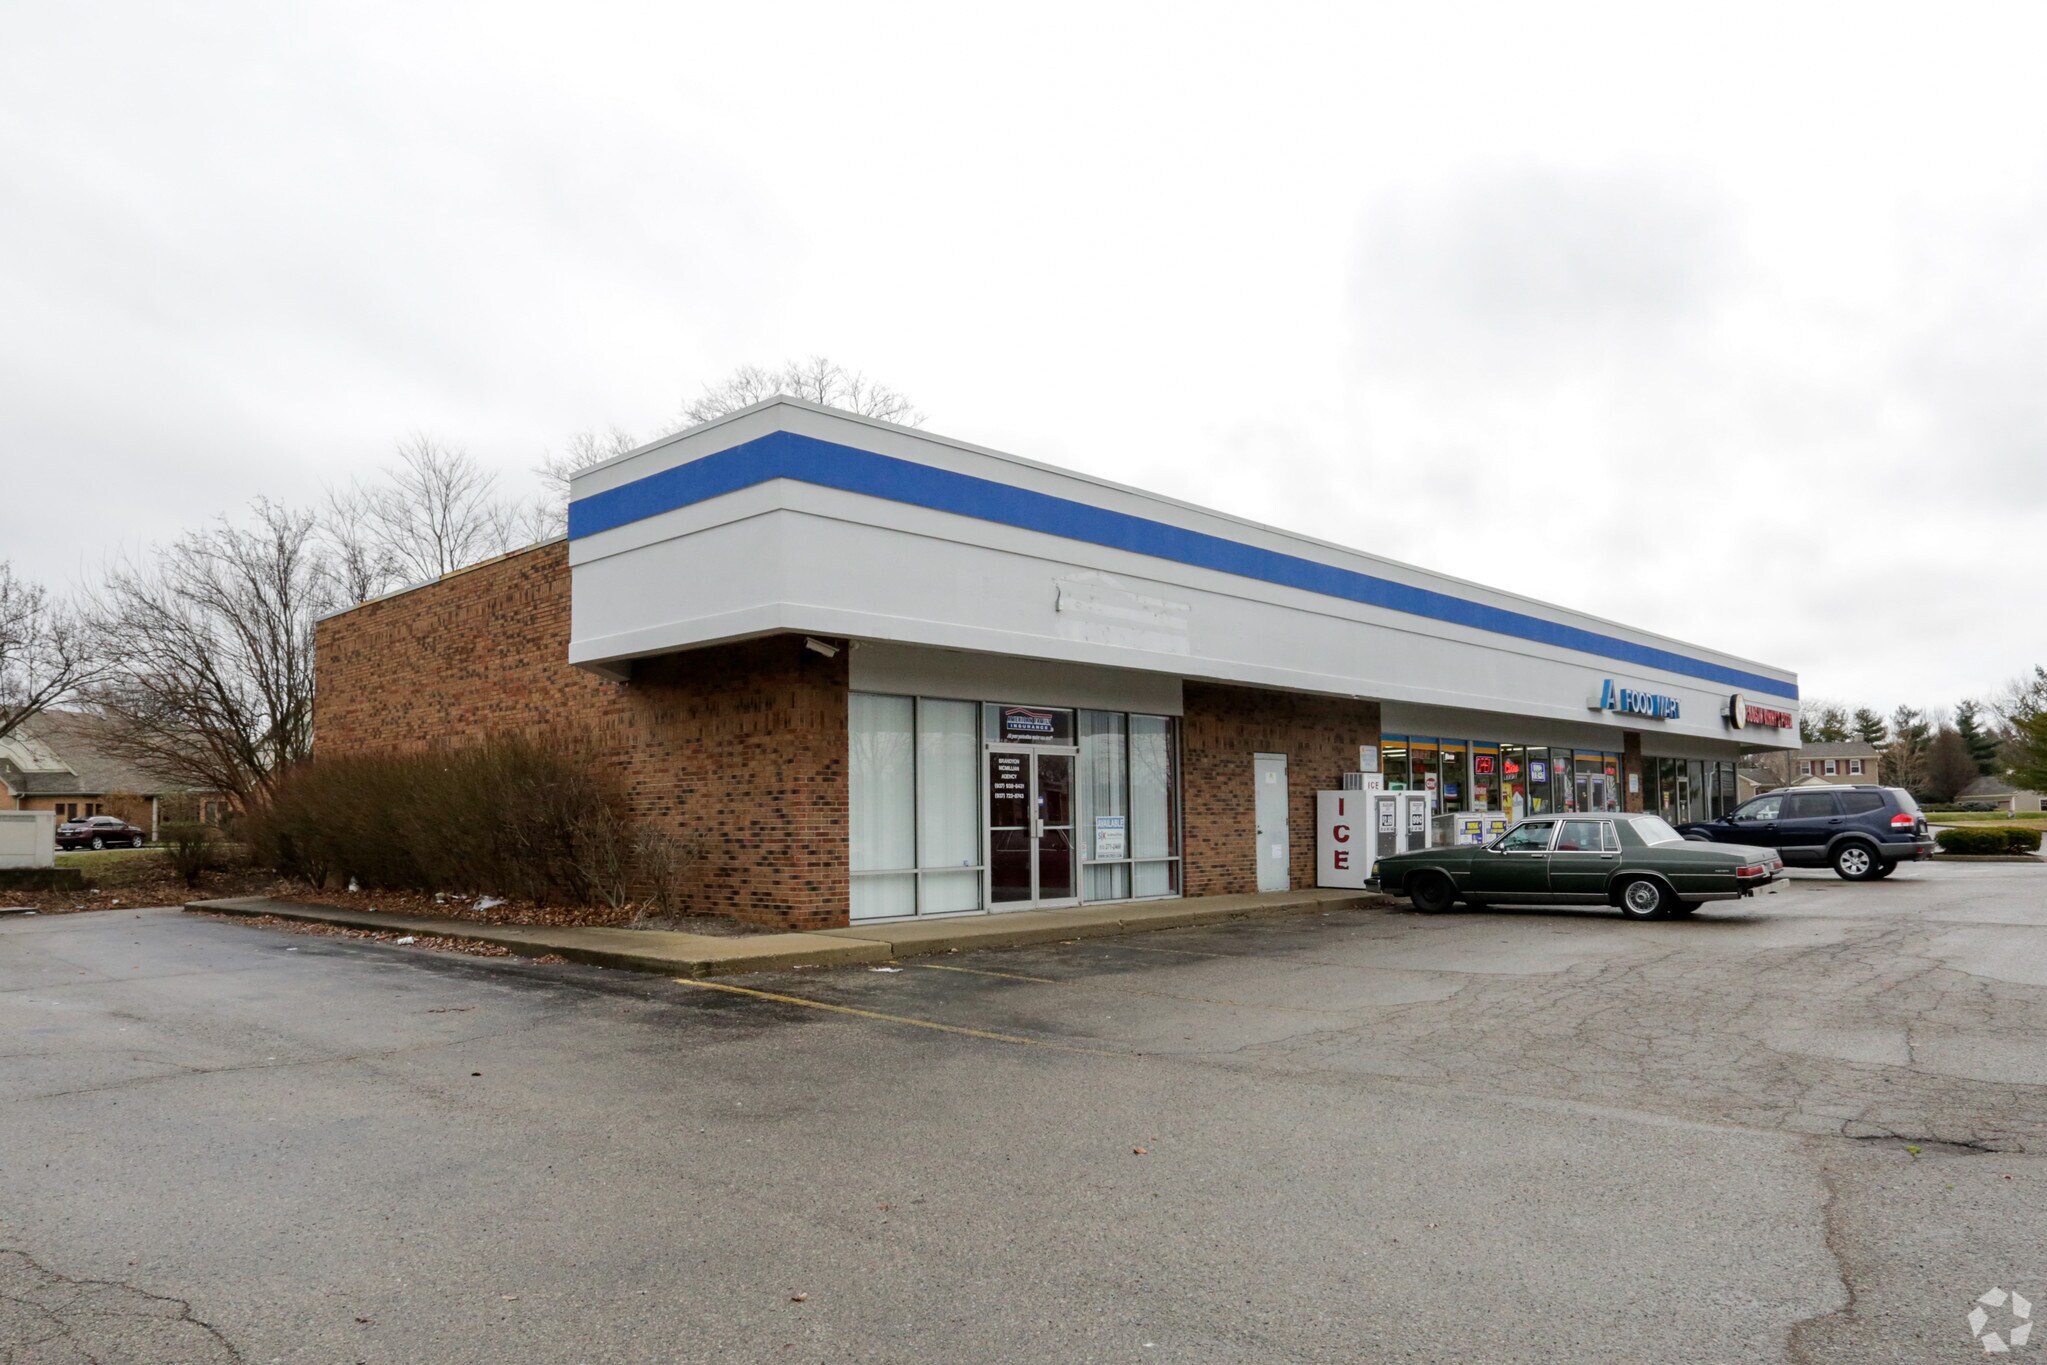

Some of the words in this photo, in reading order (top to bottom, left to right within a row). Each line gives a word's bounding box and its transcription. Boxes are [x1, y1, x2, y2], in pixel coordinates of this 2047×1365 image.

[1600, 679, 1616, 710] A
[1620, 688, 1653, 715] FOOD
[1653, 695, 1681, 719] MART
[1368, 781, 1379, 790] ICE
[1097, 818, 1124, 826] AVAILABLE
[1333, 797, 1350, 870] ICE
